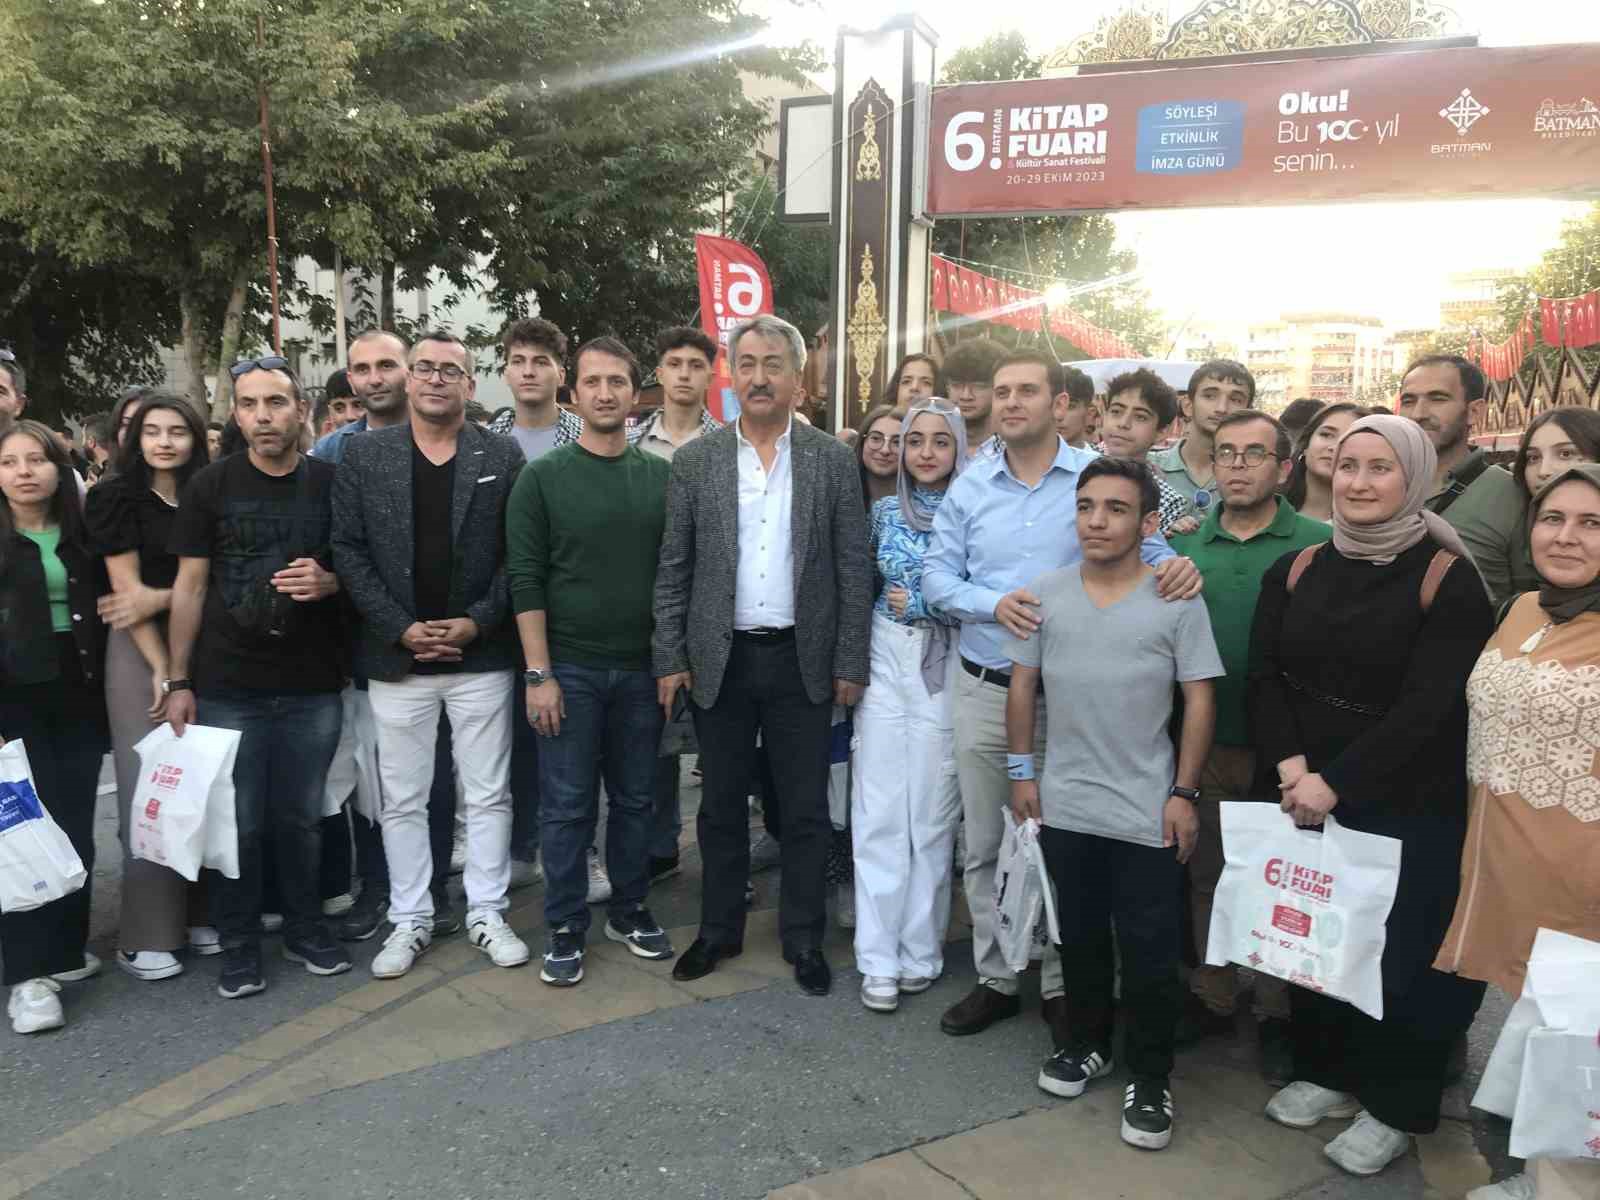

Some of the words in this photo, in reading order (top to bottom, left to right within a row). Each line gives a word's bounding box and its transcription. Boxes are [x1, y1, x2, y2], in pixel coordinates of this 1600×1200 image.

[1279, 89, 1349, 115] Oku!
[1165, 102, 1217, 120] SÖYLEŞİ
[1160, 128, 1218, 144] ETKİNLİK
[1278, 120, 1309, 143] Bu
[1008, 130, 1107, 158] FUARI
[1431, 143, 1492, 153] BATMAN
[1016, 159, 1042, 168] Kültür
[1044, 157, 1069, 167] Sanat
[1070, 156, 1106, 166] Festivali
[1151, 155, 1184, 169] İMZA
[1187, 152, 1225, 168] GÜNÜ
[1273, 148, 1355, 173] senin...
[1075, 171, 1105, 182] 2023
